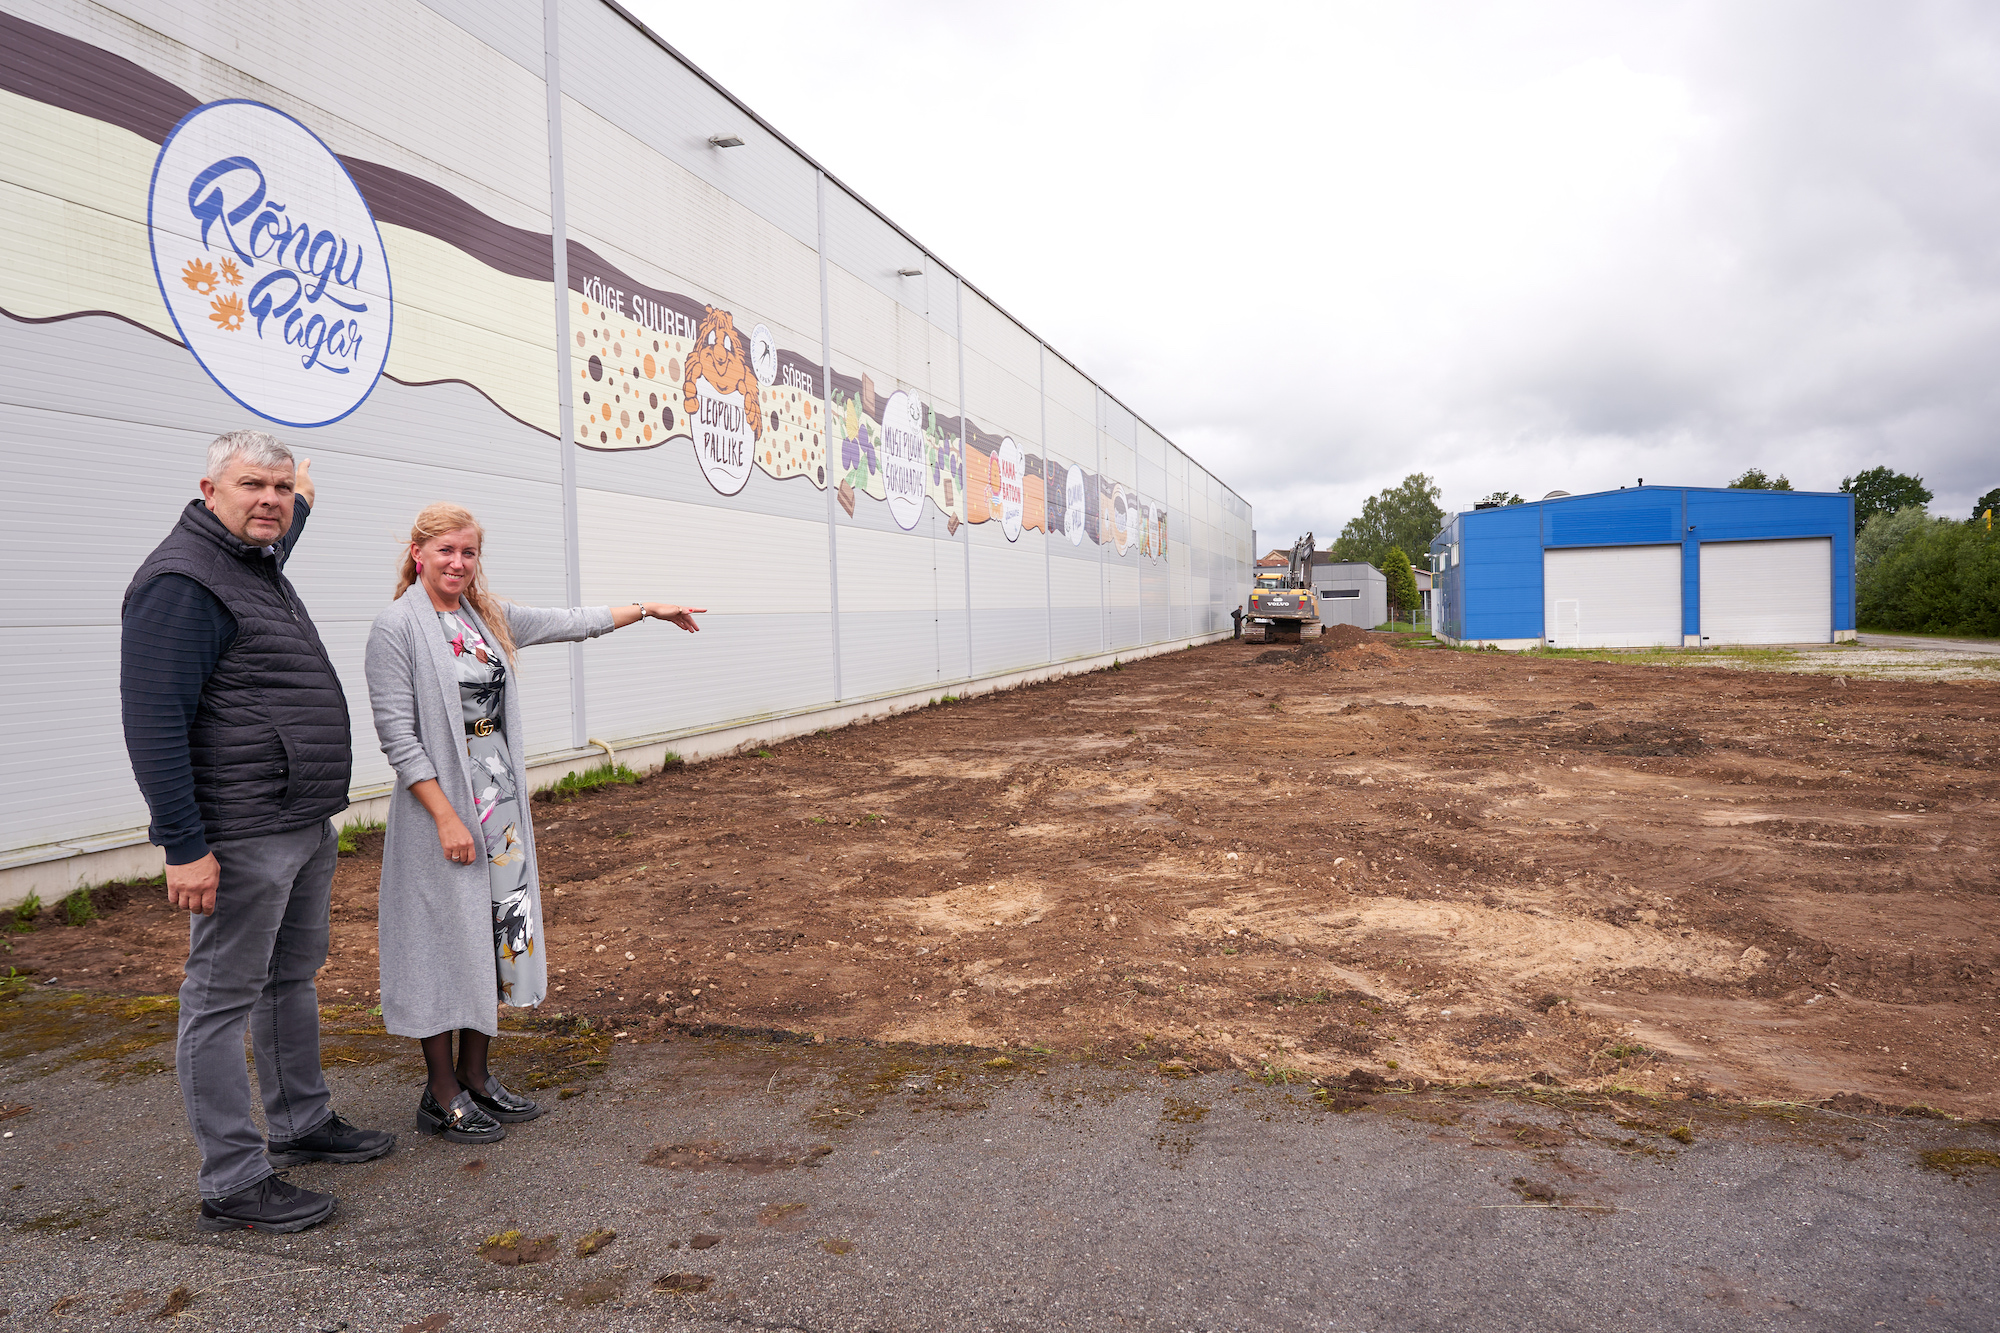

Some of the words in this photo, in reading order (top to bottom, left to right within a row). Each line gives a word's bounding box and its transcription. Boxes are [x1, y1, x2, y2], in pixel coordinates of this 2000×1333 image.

[188, 156, 368, 312] Rõngu
[248, 269, 362, 374] Pagar
[583, 276, 625, 317] KÕIGE
[632, 295, 697, 341] SUUREM
[782, 363, 813, 396] SÕBER
[700, 396, 745, 435] LEOPOLDI
[704, 432, 744, 467] PALLIKE
[885, 426, 901, 458] MUST
